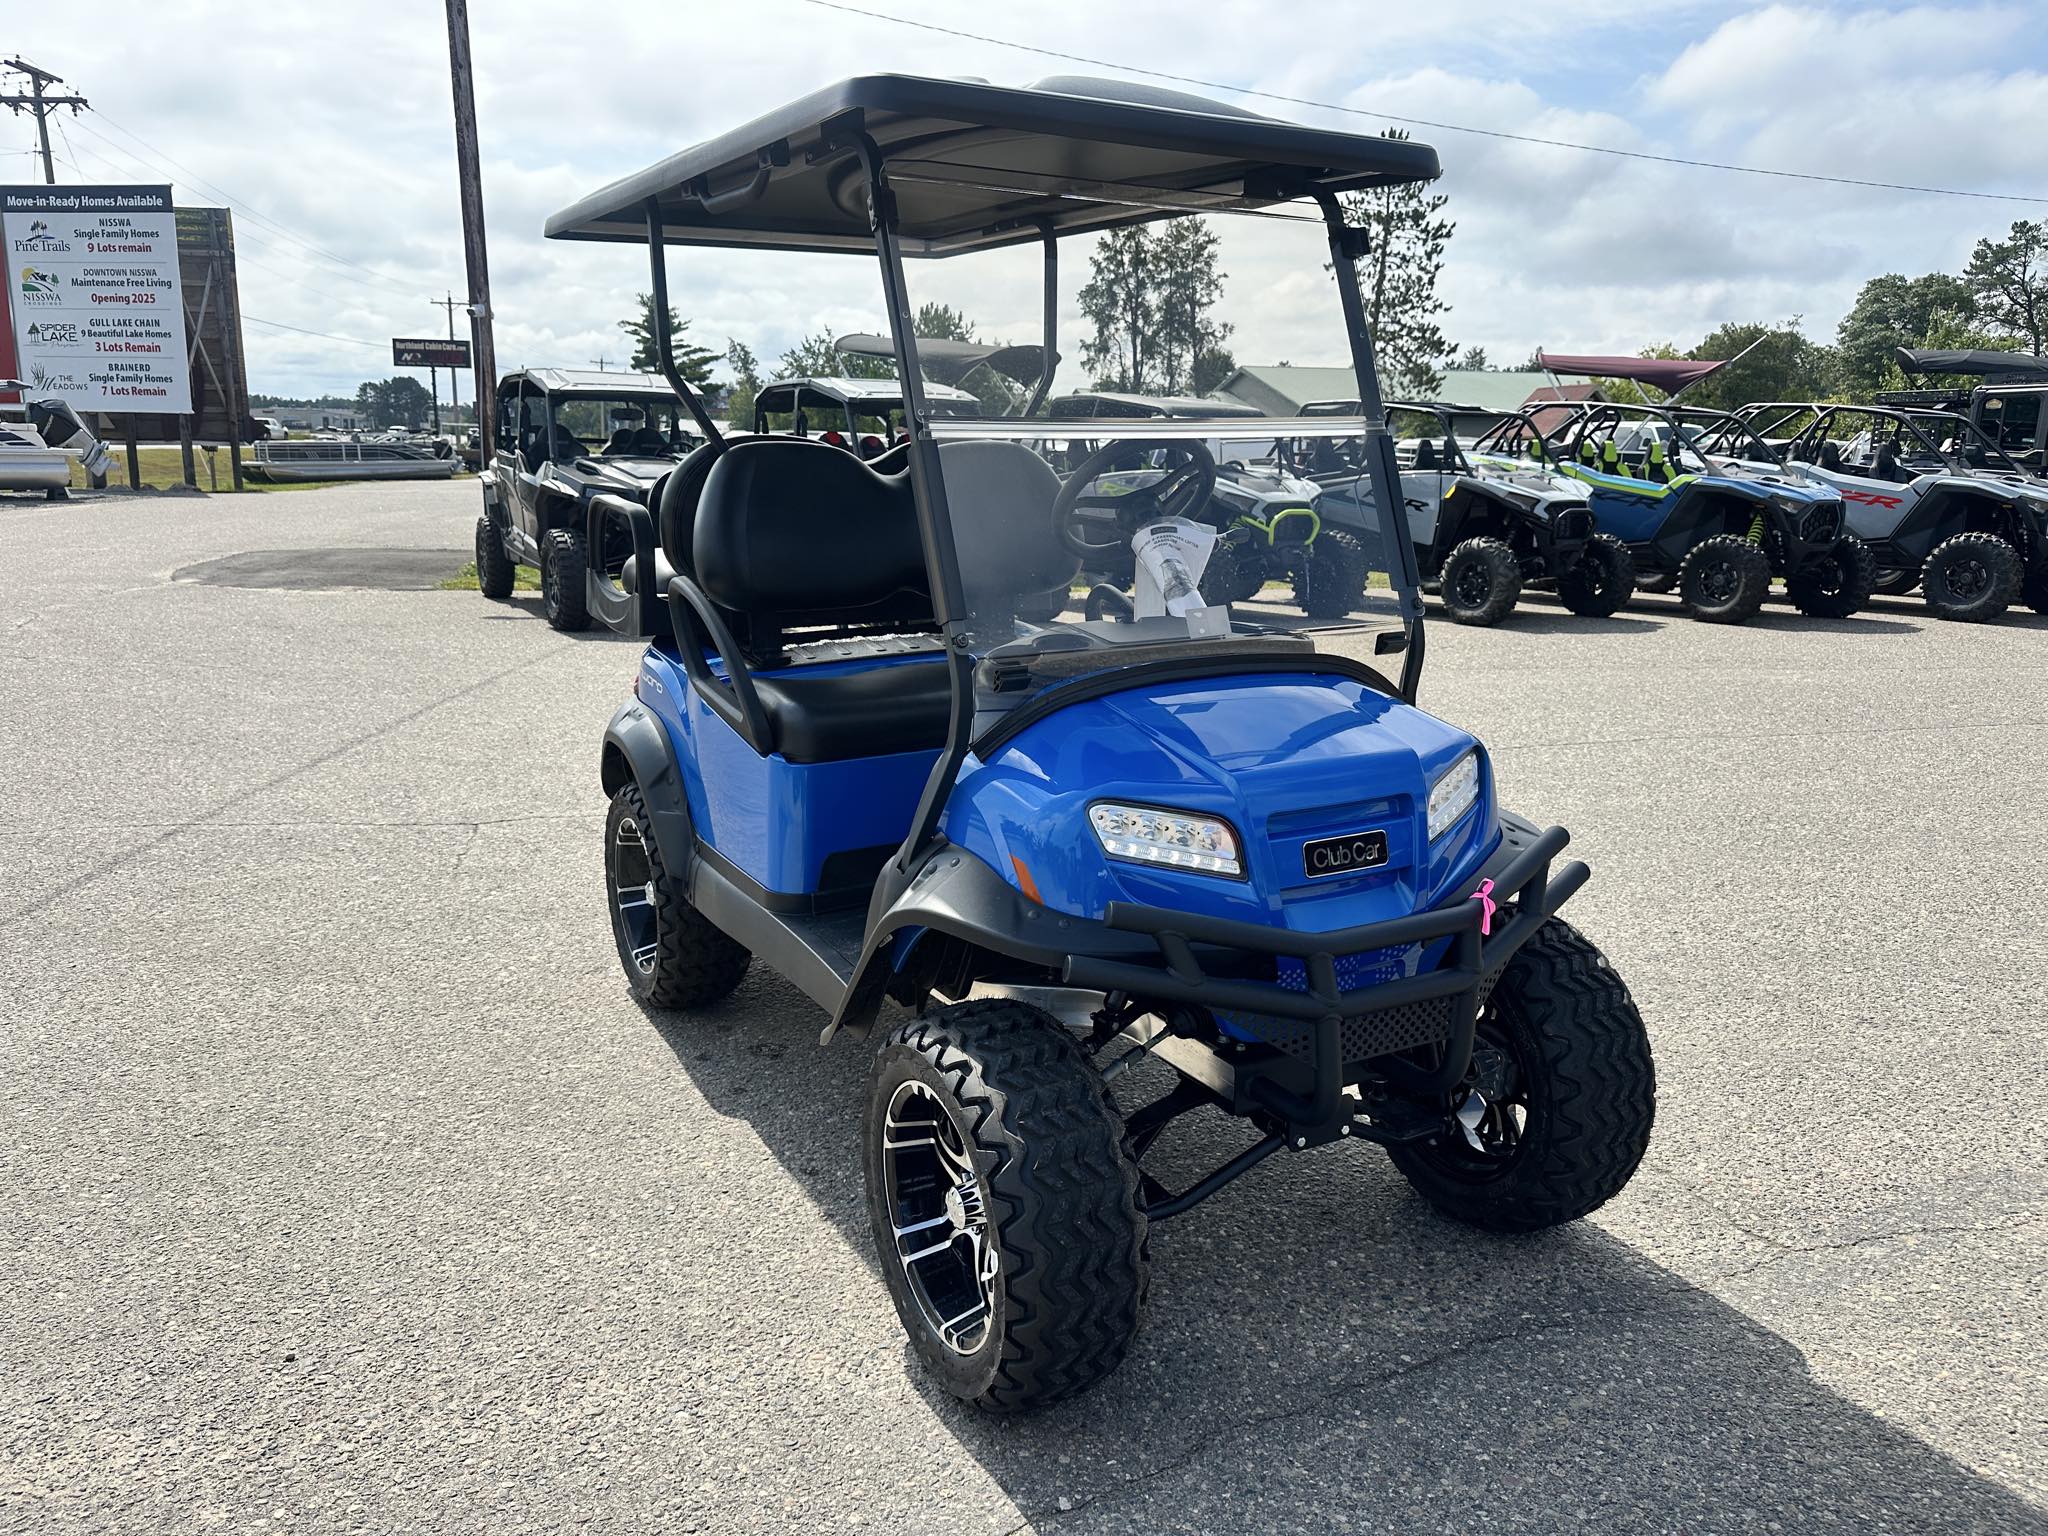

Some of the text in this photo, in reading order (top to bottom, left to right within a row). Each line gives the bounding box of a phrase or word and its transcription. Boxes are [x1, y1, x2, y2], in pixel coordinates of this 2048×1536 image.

[7, 195, 163, 209] Move-in-Ready Homes Available
[98, 218, 131, 227] NISSWA
[73, 229, 159, 240] Single Family Homes
[15, 240, 71, 251] Pine Trails
[87, 242, 152, 253] 9 Lots remain
[83, 268, 157, 276] DOWNTOWN NISSWA
[71, 278, 172, 289] Maintenance Free Living
[23, 293, 62, 301] NISSWA
[91, 293, 156, 305] Opening 2025
[40, 323, 76, 332] SPIDER
[89, 318, 161, 327] GULL LAKE CHAIN
[41, 332, 78, 342] LAKE
[80, 329, 172, 339] 9 Beautiful Lake Homes
[95, 342, 102, 352] 3
[103, 342, 123, 352] Lots
[124, 342, 162, 353] Remain
[108, 363, 151, 372] BRAINERD
[58, 374, 73, 382] THE
[88, 373, 173, 384] Single Family Homes
[101, 386, 167, 396] 7 Lots Remain
[1840, 489, 1904, 509] ZR
[1313, 842, 1381, 868] Club Car
